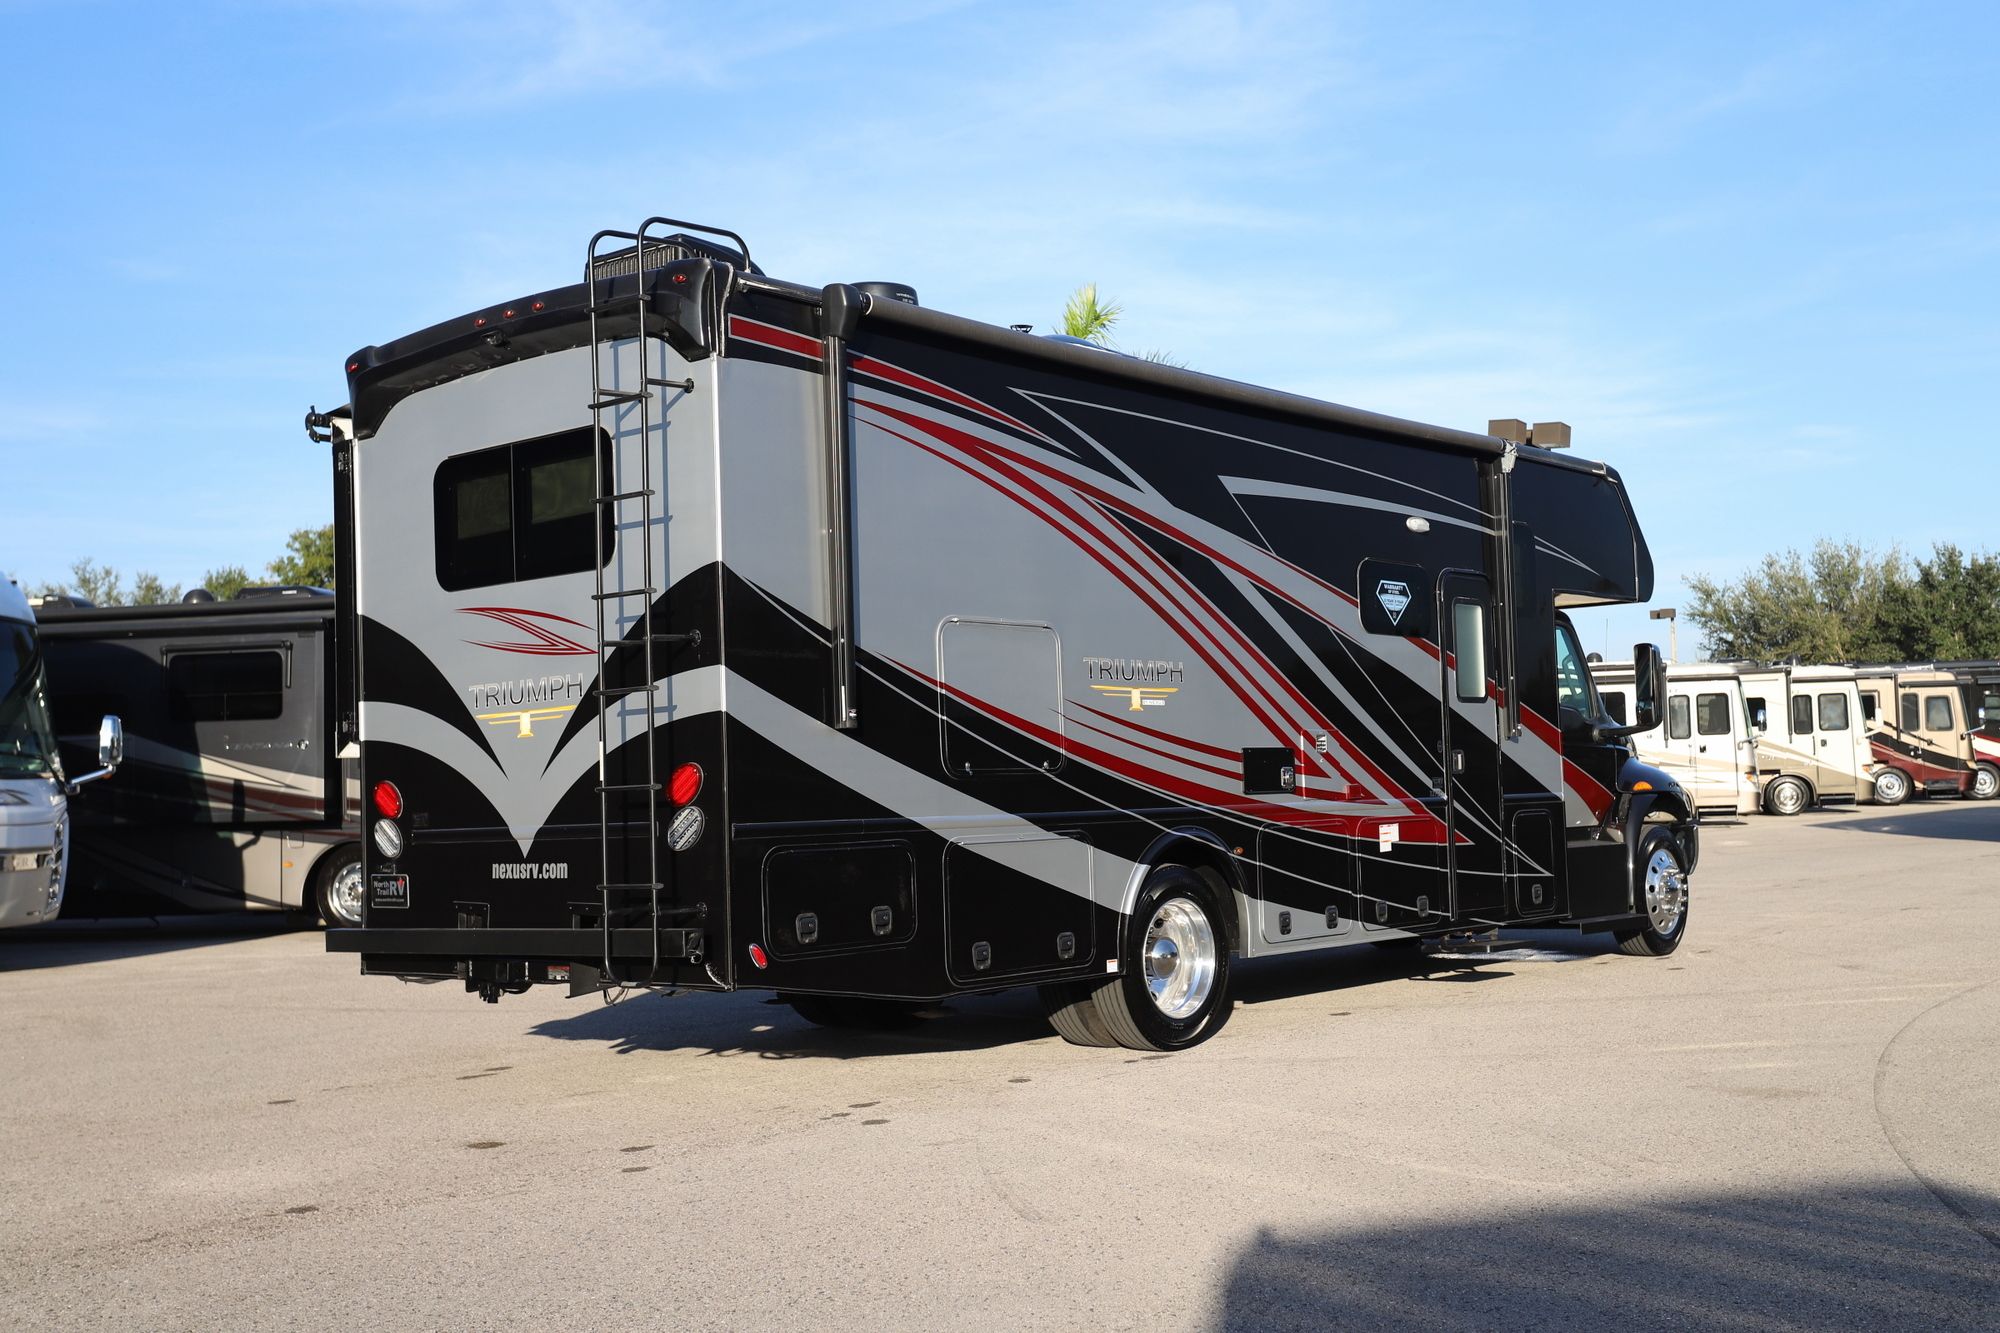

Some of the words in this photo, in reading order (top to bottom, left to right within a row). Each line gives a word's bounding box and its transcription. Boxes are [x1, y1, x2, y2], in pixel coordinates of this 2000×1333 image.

[1083, 657, 1184, 682] TRIUMPH
[468, 673, 583, 708] TRIUMPH
[492, 862, 568, 879] nexusrv.com
[373, 880, 390, 889] North
[377, 888, 390, 896] Trail
[390, 880, 405, 896] RV
